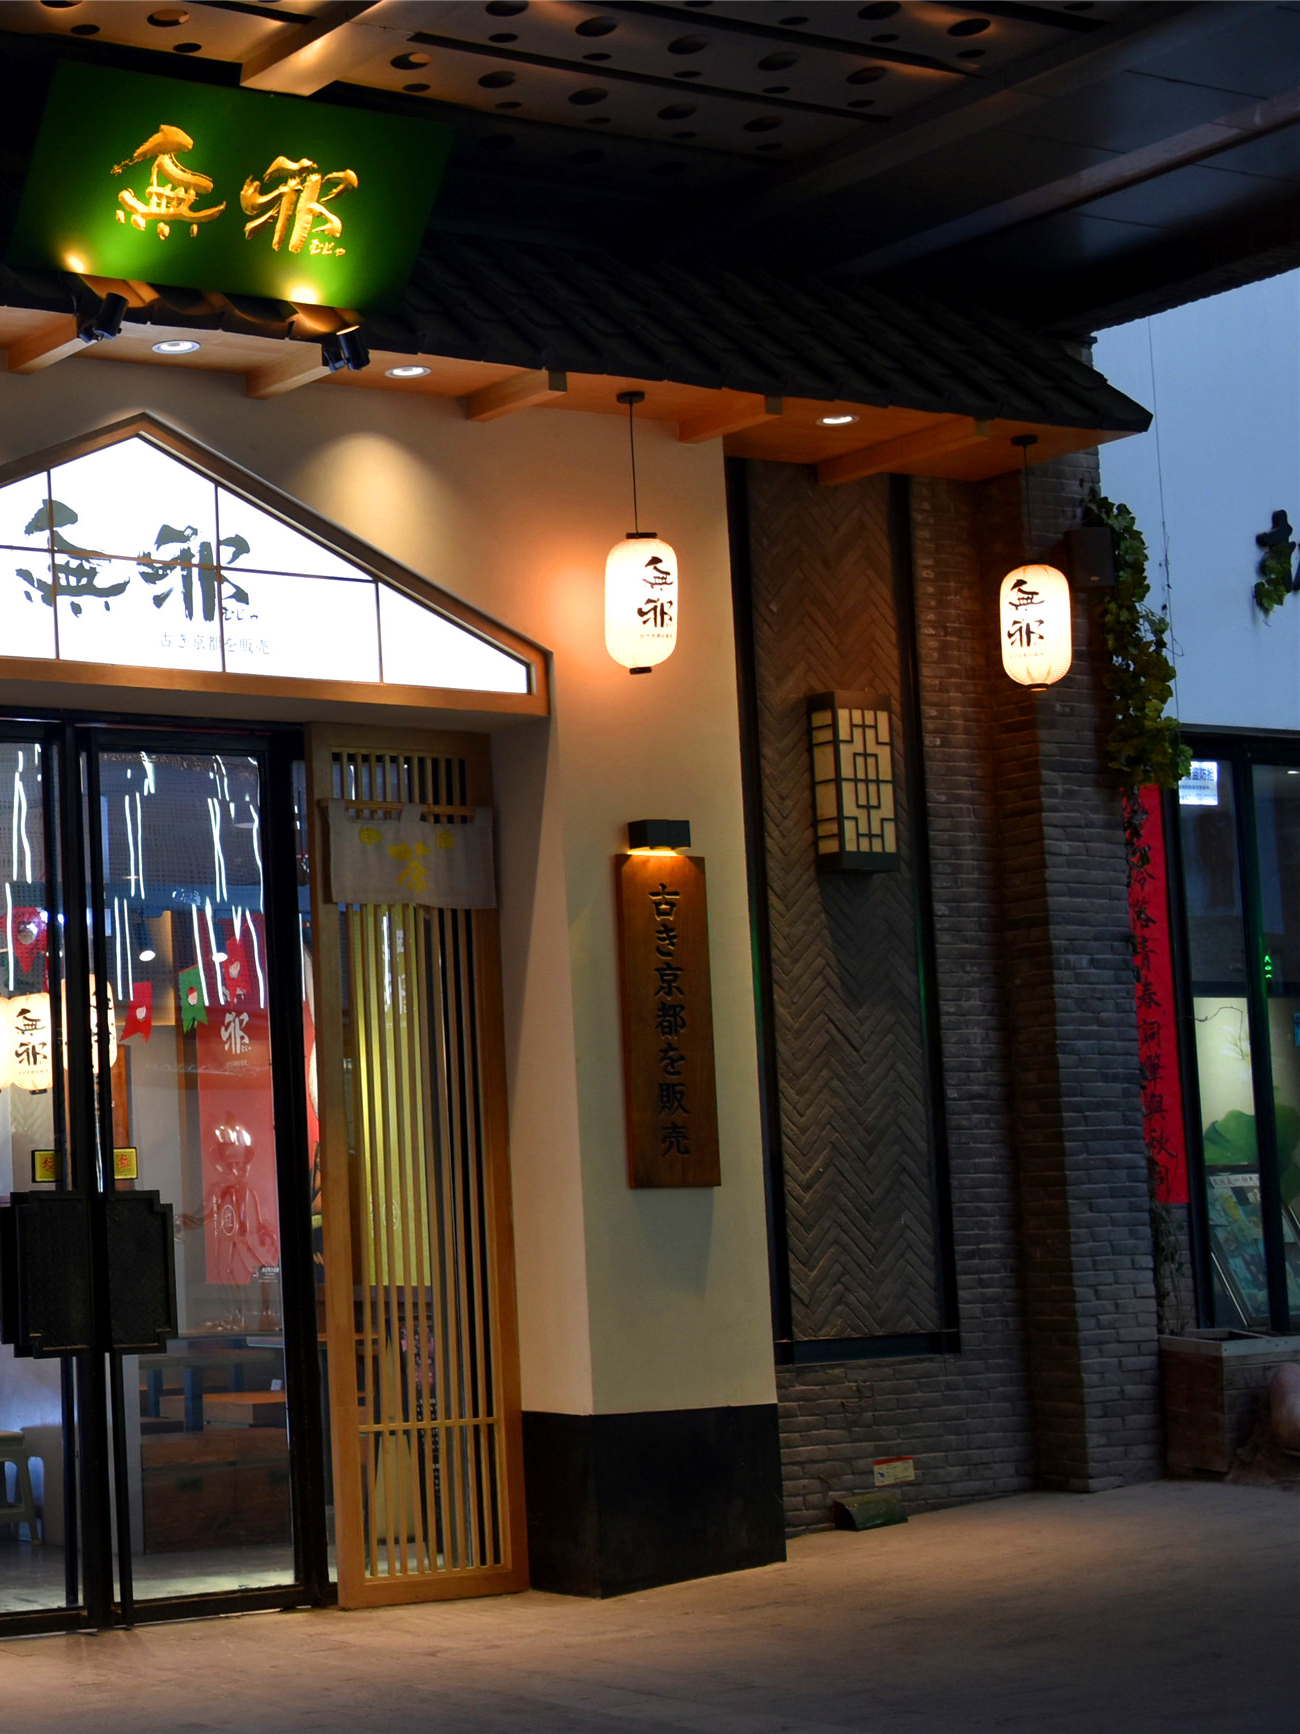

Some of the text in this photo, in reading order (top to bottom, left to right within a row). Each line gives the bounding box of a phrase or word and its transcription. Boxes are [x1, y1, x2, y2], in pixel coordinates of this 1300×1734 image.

[649, 882, 692, 1157] 古き京都を販売
